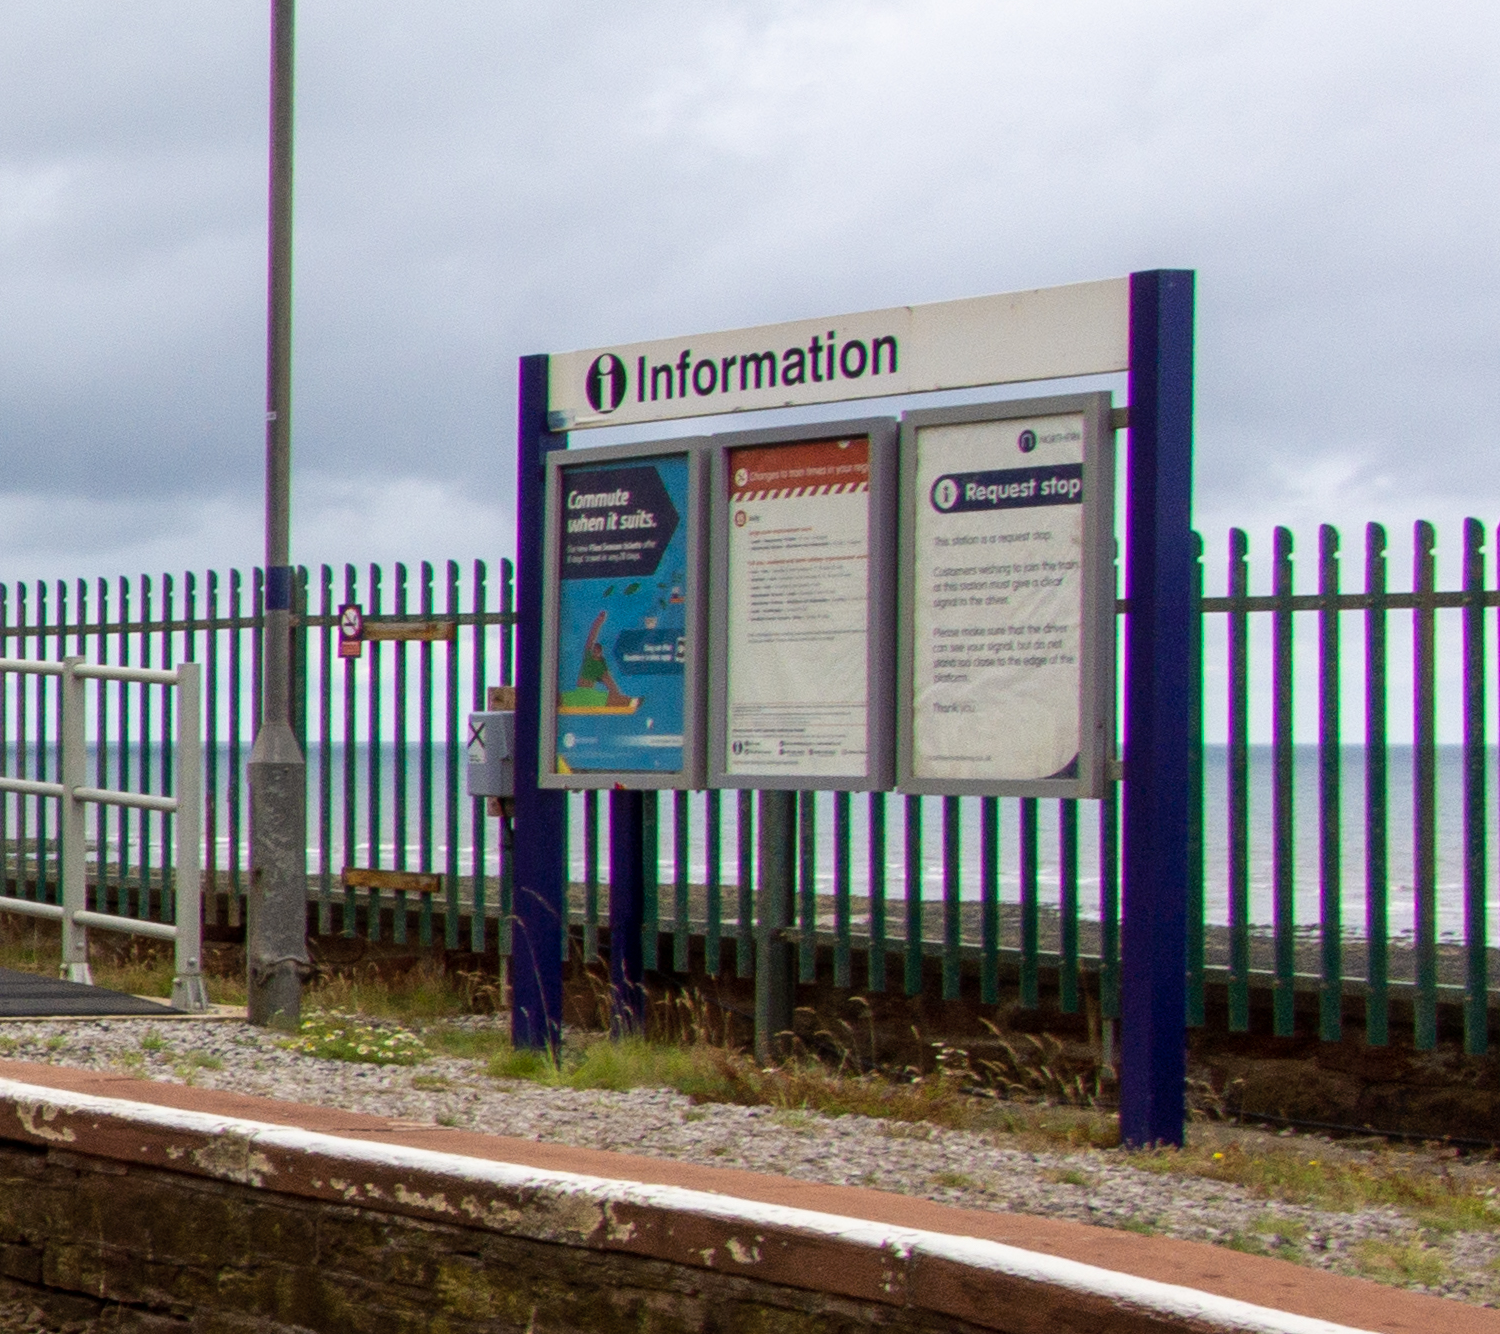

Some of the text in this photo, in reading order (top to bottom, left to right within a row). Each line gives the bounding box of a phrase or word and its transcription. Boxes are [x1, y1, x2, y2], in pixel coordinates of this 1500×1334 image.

[636, 330, 898, 403] Information
[568, 488, 630, 510] Commute
[965, 479, 1035, 504] Request
[1040, 475, 1081, 498] stop
[568, 508, 657, 533] when it suits.
